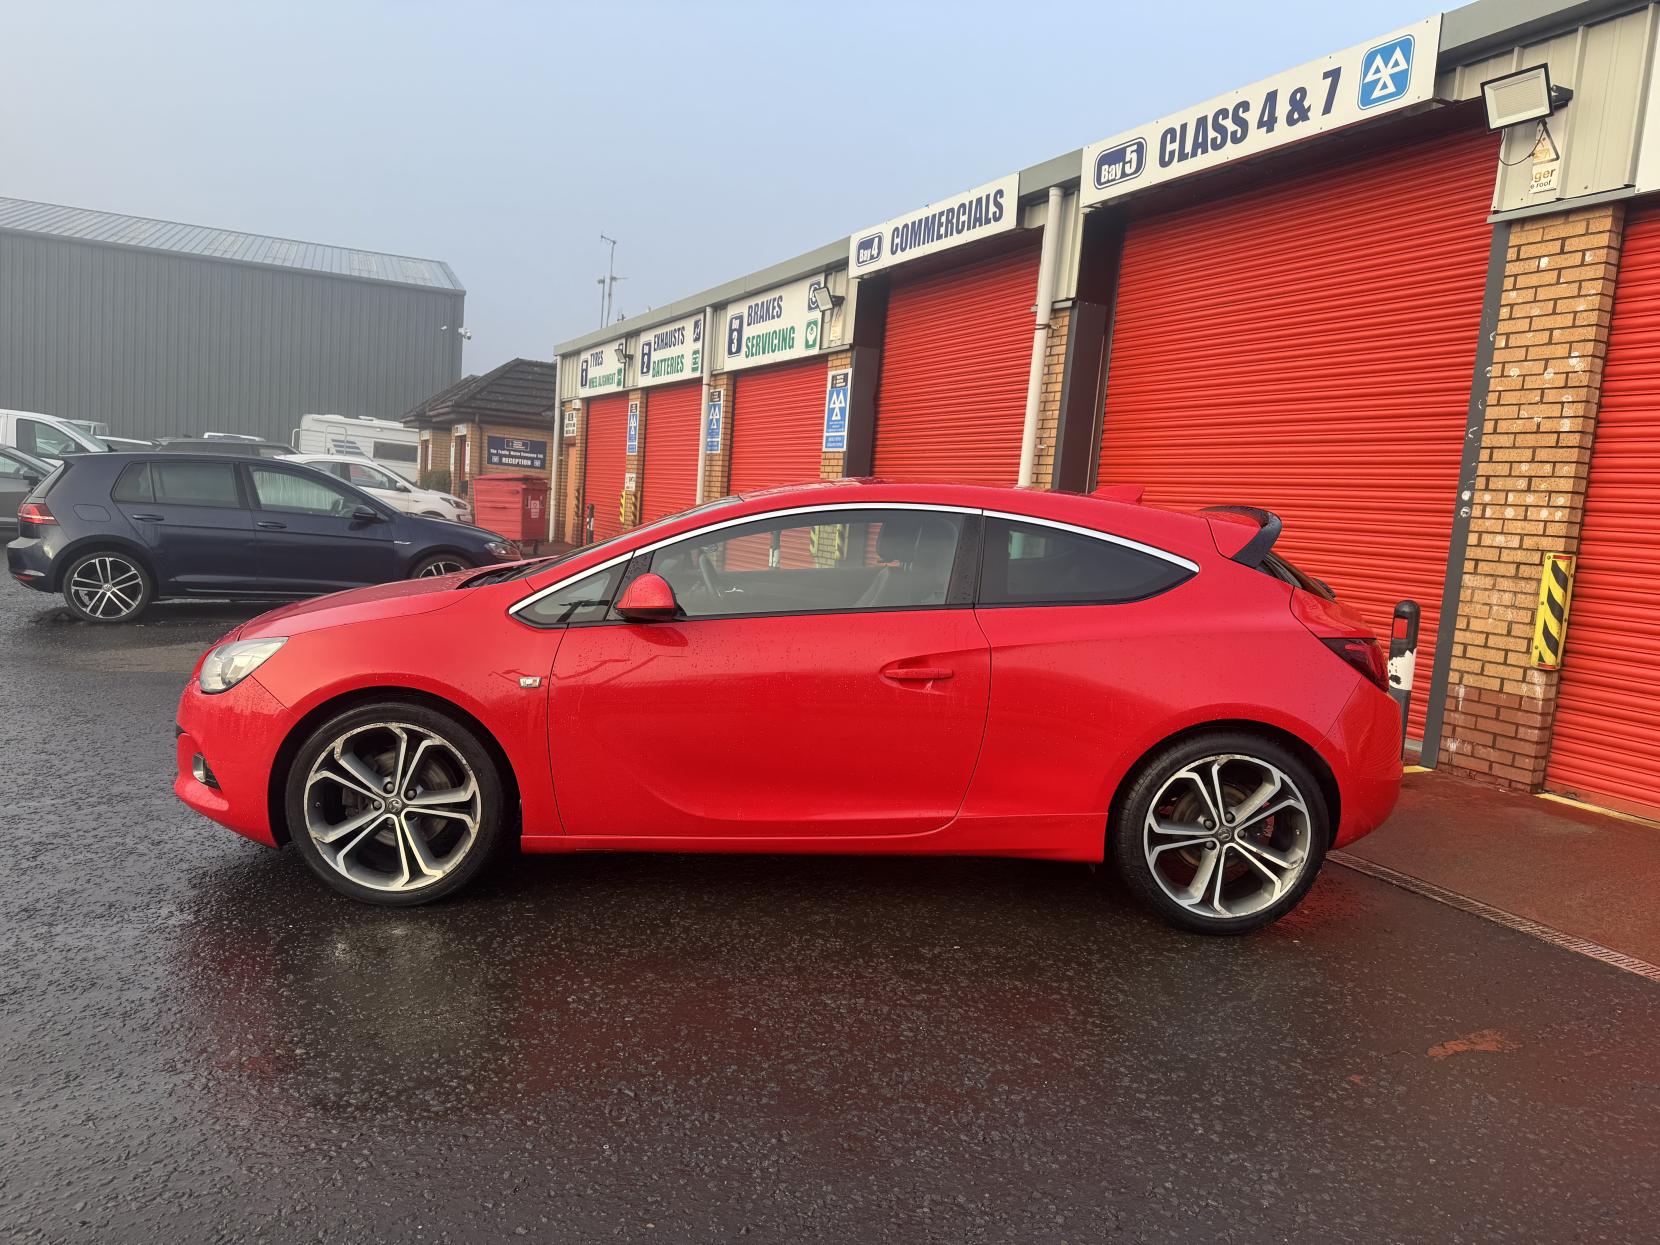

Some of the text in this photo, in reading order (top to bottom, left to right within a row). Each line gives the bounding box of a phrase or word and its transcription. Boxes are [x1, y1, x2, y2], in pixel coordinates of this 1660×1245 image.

[1158, 66, 1342, 169] CLASS 4 & 7
[1101, 146, 1137, 183] Bay 5
[1531, 169, 1556, 182] ger
[1536, 180, 1551, 188] roof
[890, 188, 1004, 256] COMMERCIALS
[859, 238, 878, 262] Bay 4
[747, 295, 783, 327] BRAKES
[653, 326, 685, 352] EXHAUSTS
[731, 330, 738, 353] 3
[745, 325, 796, 359] SERVICING
[590, 349, 603, 368] TYRES
[643, 354, 648, 372] 2
[652, 354, 685, 378] BATTERIES
[502, 457, 531, 465] RECEPTION
